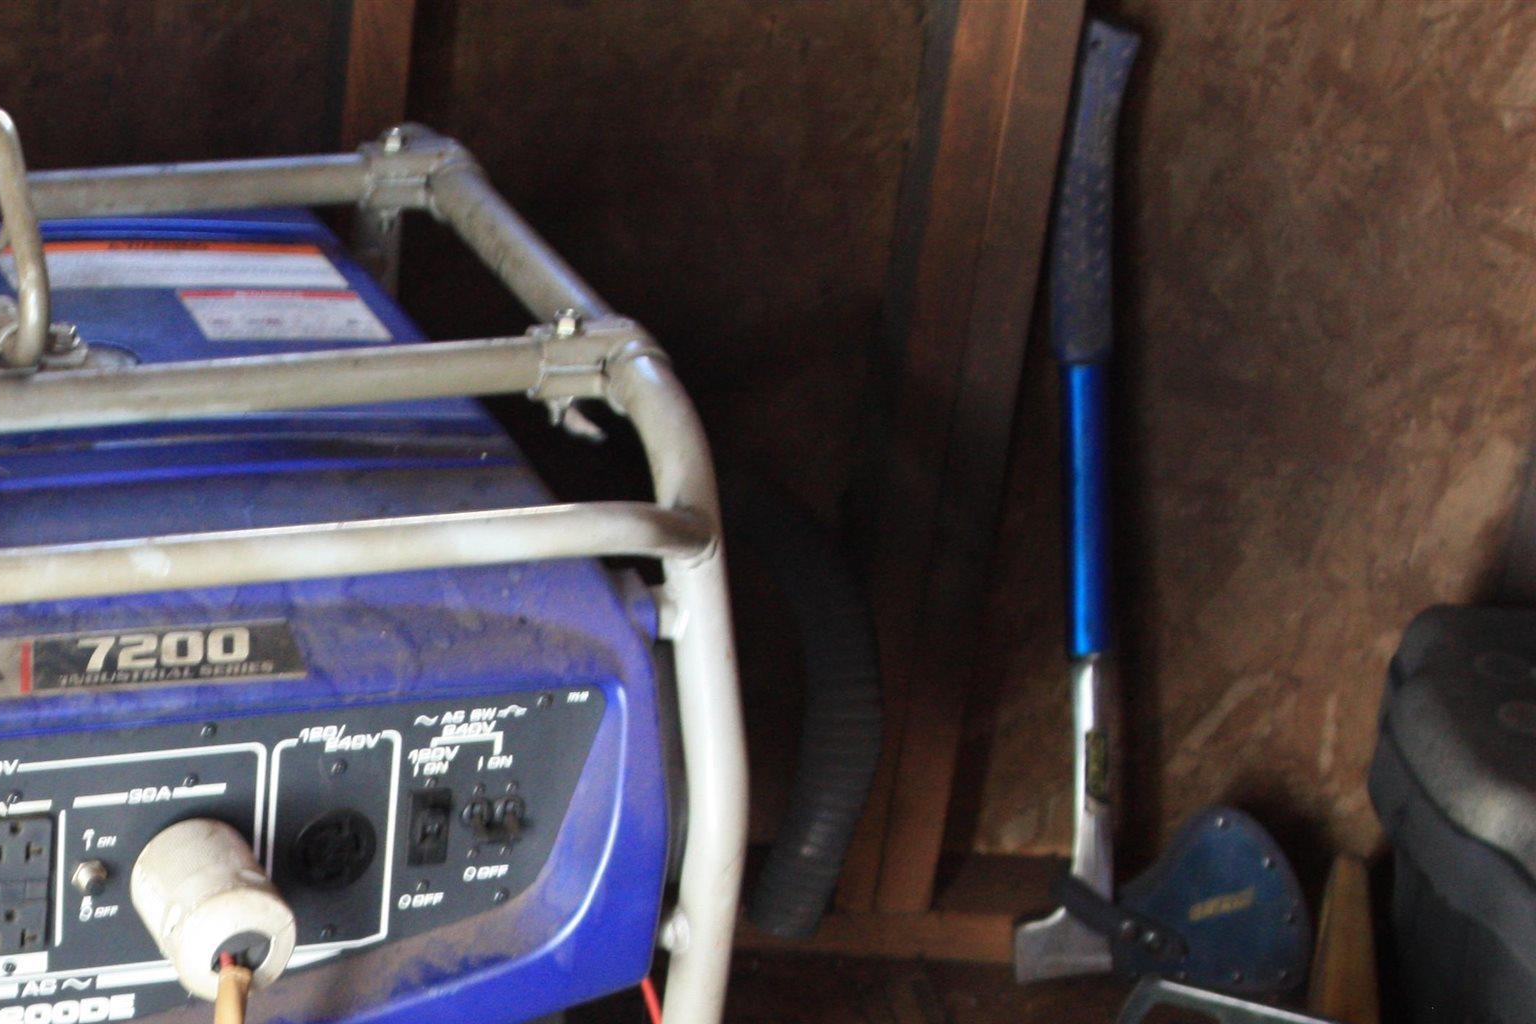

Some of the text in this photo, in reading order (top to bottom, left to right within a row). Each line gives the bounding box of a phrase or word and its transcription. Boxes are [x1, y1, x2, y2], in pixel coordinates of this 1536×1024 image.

[77, 626, 250, 673] 7200
[59, 665, 193, 687] INDUSTRIAL
[477, 864, 510, 880] OFF
[412, 892, 444, 908] OFF
[20, 977, 58, 999] AC
